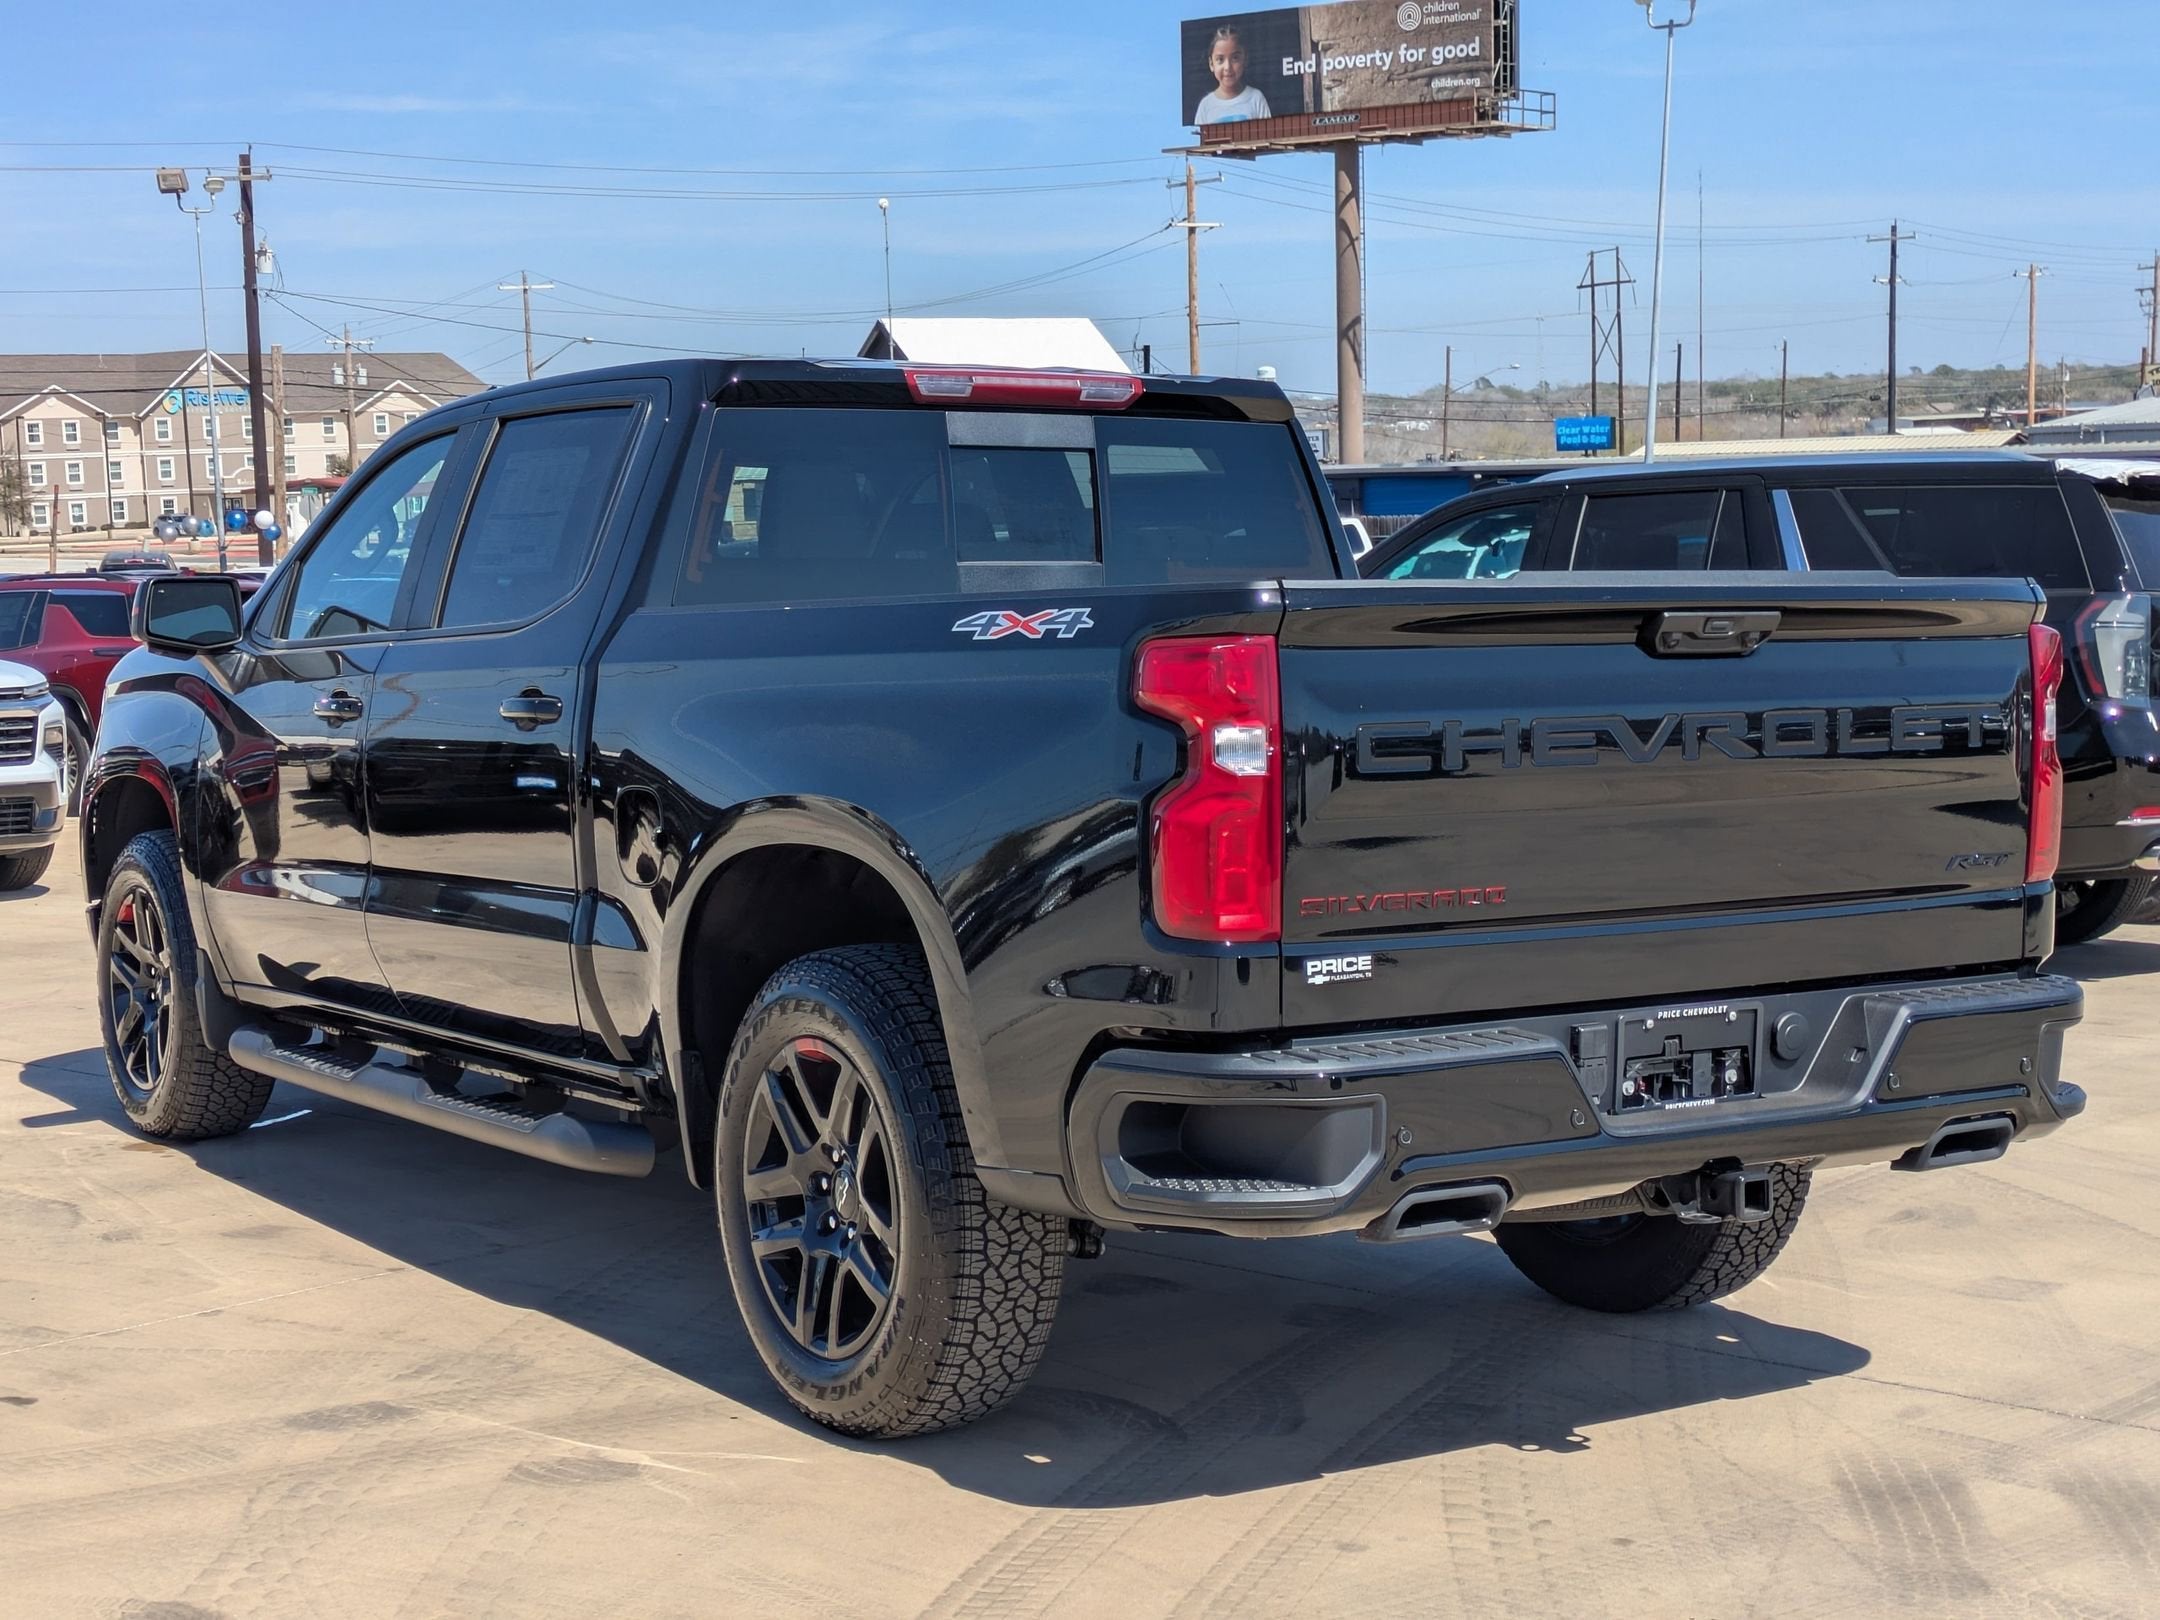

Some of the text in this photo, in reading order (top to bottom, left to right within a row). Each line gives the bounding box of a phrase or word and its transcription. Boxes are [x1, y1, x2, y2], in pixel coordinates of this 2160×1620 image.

[1423, 1, 1460, 13] children
[1423, 8, 1481, 25] international
[1282, 36, 1480, 76] End poverty for good
[1431, 77, 1481, 88] children.org
[1314, 115, 1356, 125] LAMAR
[1557, 424, 1610, 435] Clear Water
[1560, 434, 1581, 444] Pool
[1590, 434, 1607, 444] Spa
[1356, 704, 2001, 773] CHEVROLET
[1944, 851, 2014, 872] RST
[1300, 886, 1508, 917] SILVERADO
[1307, 956, 1372, 976] PRICE
[1658, 1005, 1728, 1019] PRICE CHEVROLET
